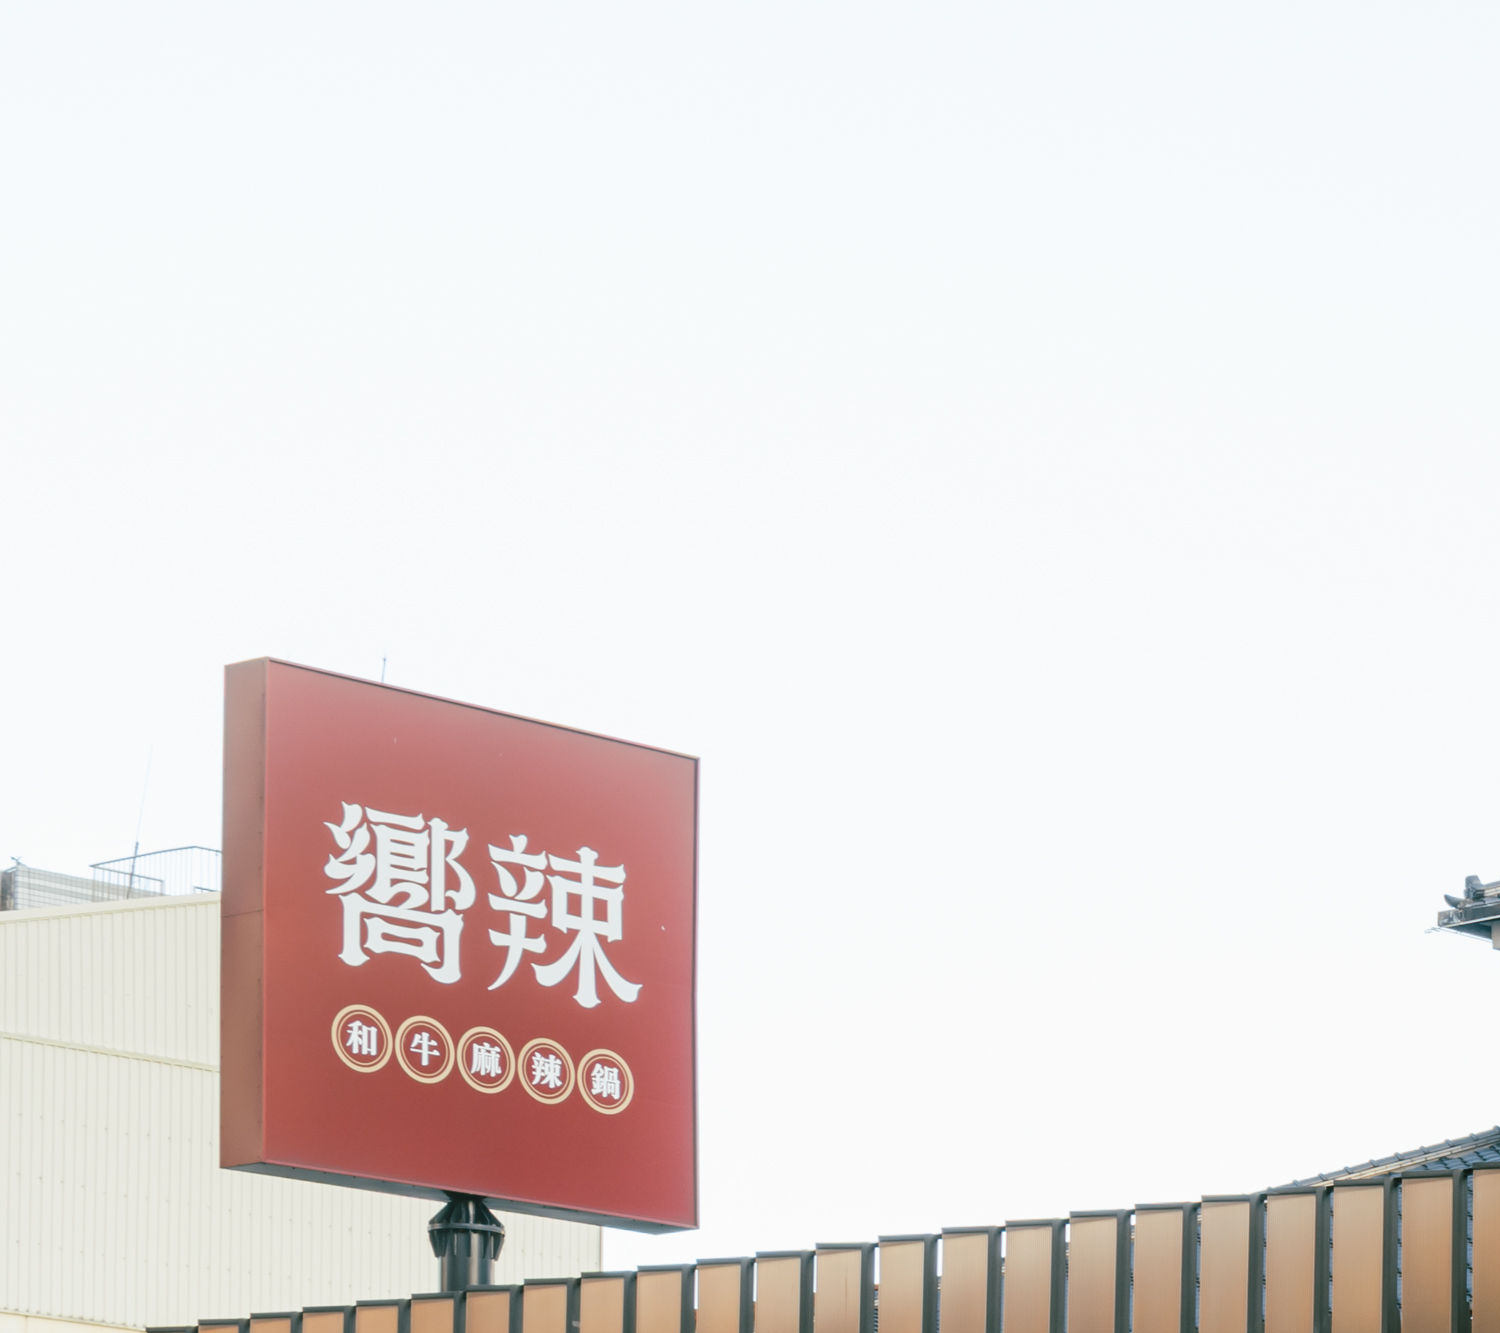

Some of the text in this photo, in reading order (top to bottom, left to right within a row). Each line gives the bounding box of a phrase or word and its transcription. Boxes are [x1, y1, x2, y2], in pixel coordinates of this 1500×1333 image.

[324, 801, 643, 1009] 嚮辣
[342, 1016, 626, 1105] 和牛麻辣鍋
